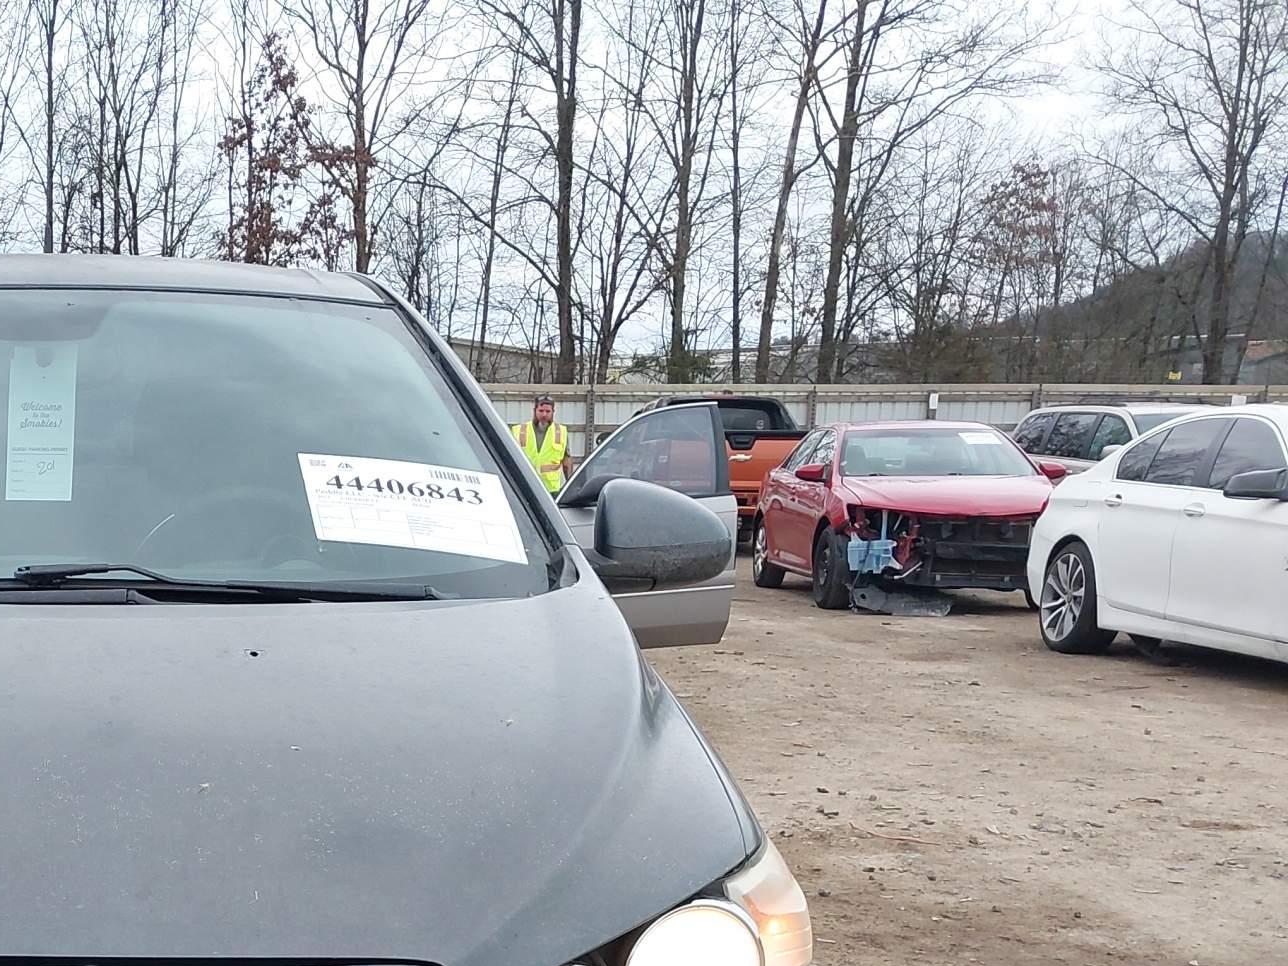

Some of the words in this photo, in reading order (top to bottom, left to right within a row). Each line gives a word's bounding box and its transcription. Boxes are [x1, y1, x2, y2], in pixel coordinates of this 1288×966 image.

[20, 401, 63, 411] Welcome
[20, 418, 63, 429] Smokies!
[326, 474, 483, 505] 44406843
